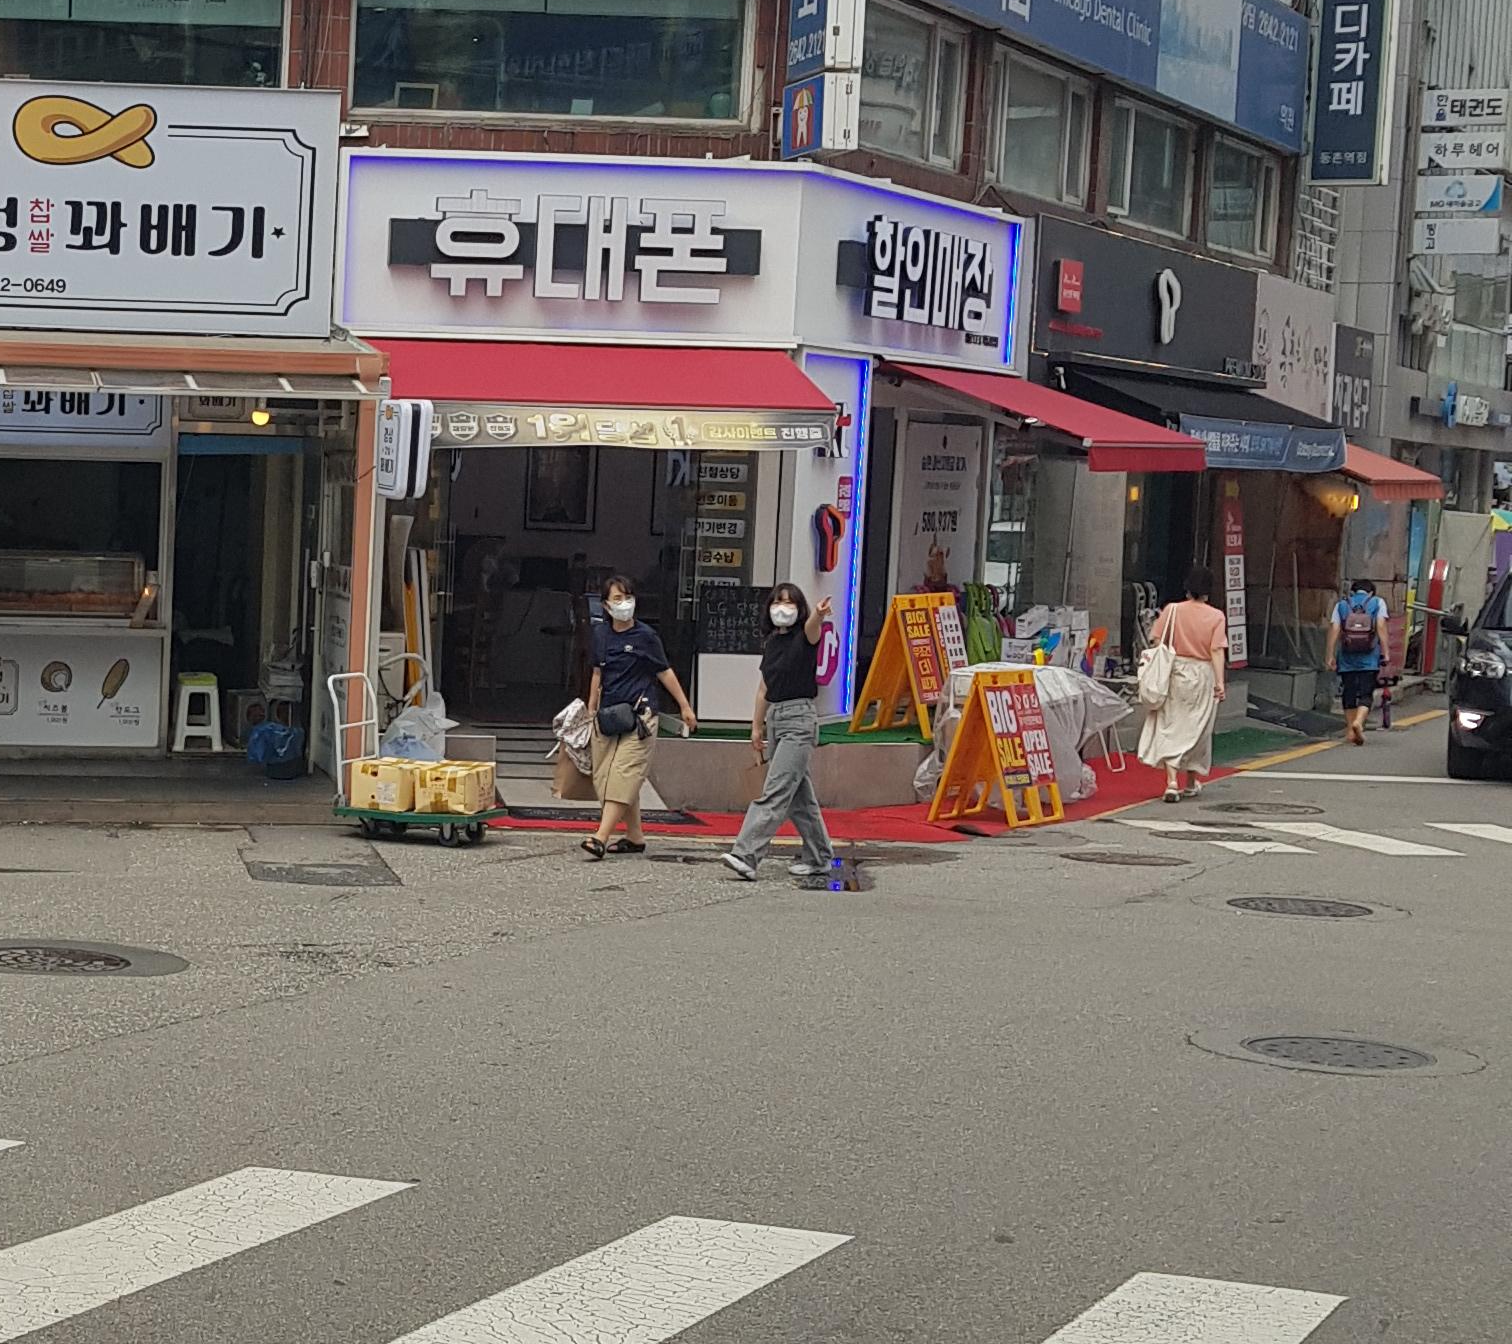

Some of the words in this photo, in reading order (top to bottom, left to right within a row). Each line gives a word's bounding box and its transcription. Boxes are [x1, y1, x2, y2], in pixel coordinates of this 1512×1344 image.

[1127, 13, 1152, 47] Clinic
[1451, 98, 1502, 118] 태권도
[28, 197, 55, 256] 찹쌀
[64, 198, 267, 260] 꽈배기
[430, 189, 727, 304] 휴대폰
[867, 214, 994, 332] 할인매장
[907, 624, 931, 638] SALE
[986, 690, 1017, 734] BIG
[1022, 729, 1049, 752] OPEN
[997, 737, 1026, 767] SALE
[1027, 752, 1054, 776] SALE
